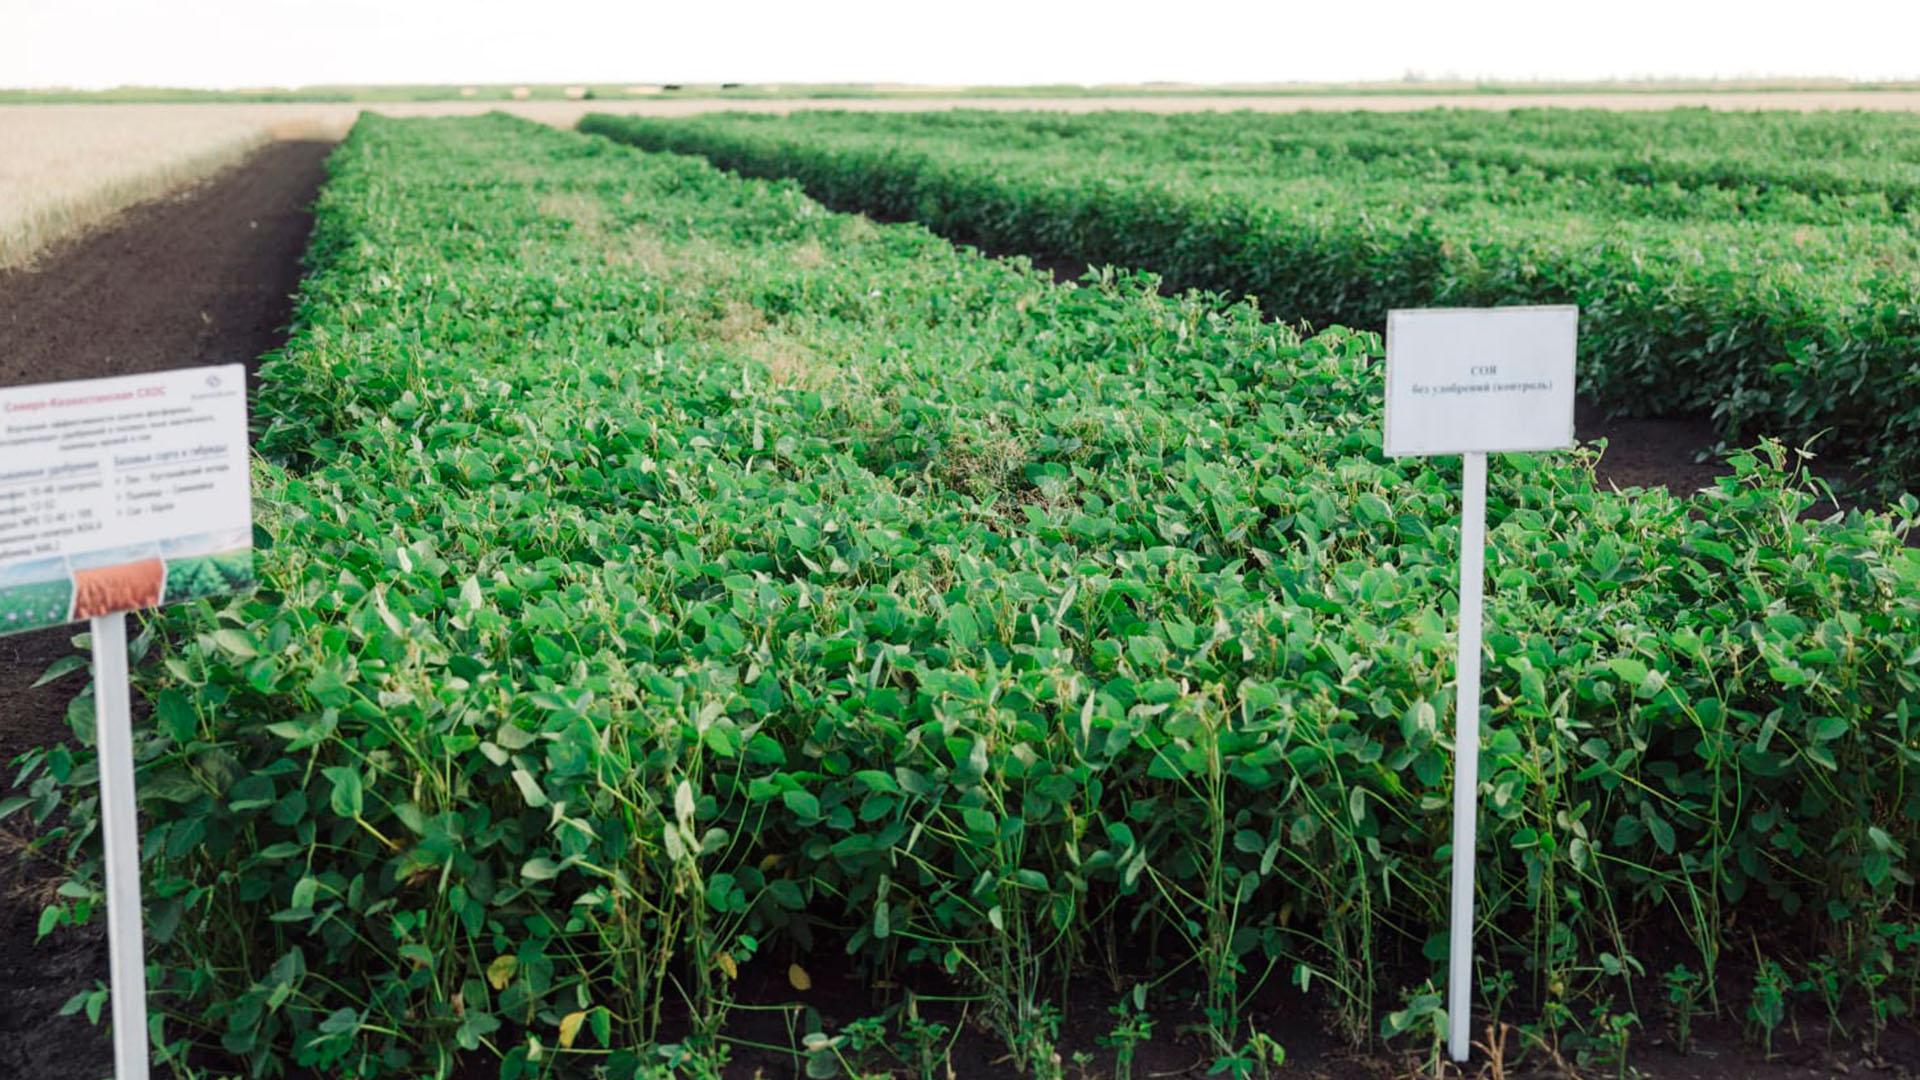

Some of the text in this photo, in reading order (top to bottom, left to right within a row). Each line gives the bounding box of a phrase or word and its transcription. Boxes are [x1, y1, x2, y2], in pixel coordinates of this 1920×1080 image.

[1470, 365, 1497, 376] СОЯ
[1412, 380, 1553, 396] без удобрений (контроль)
